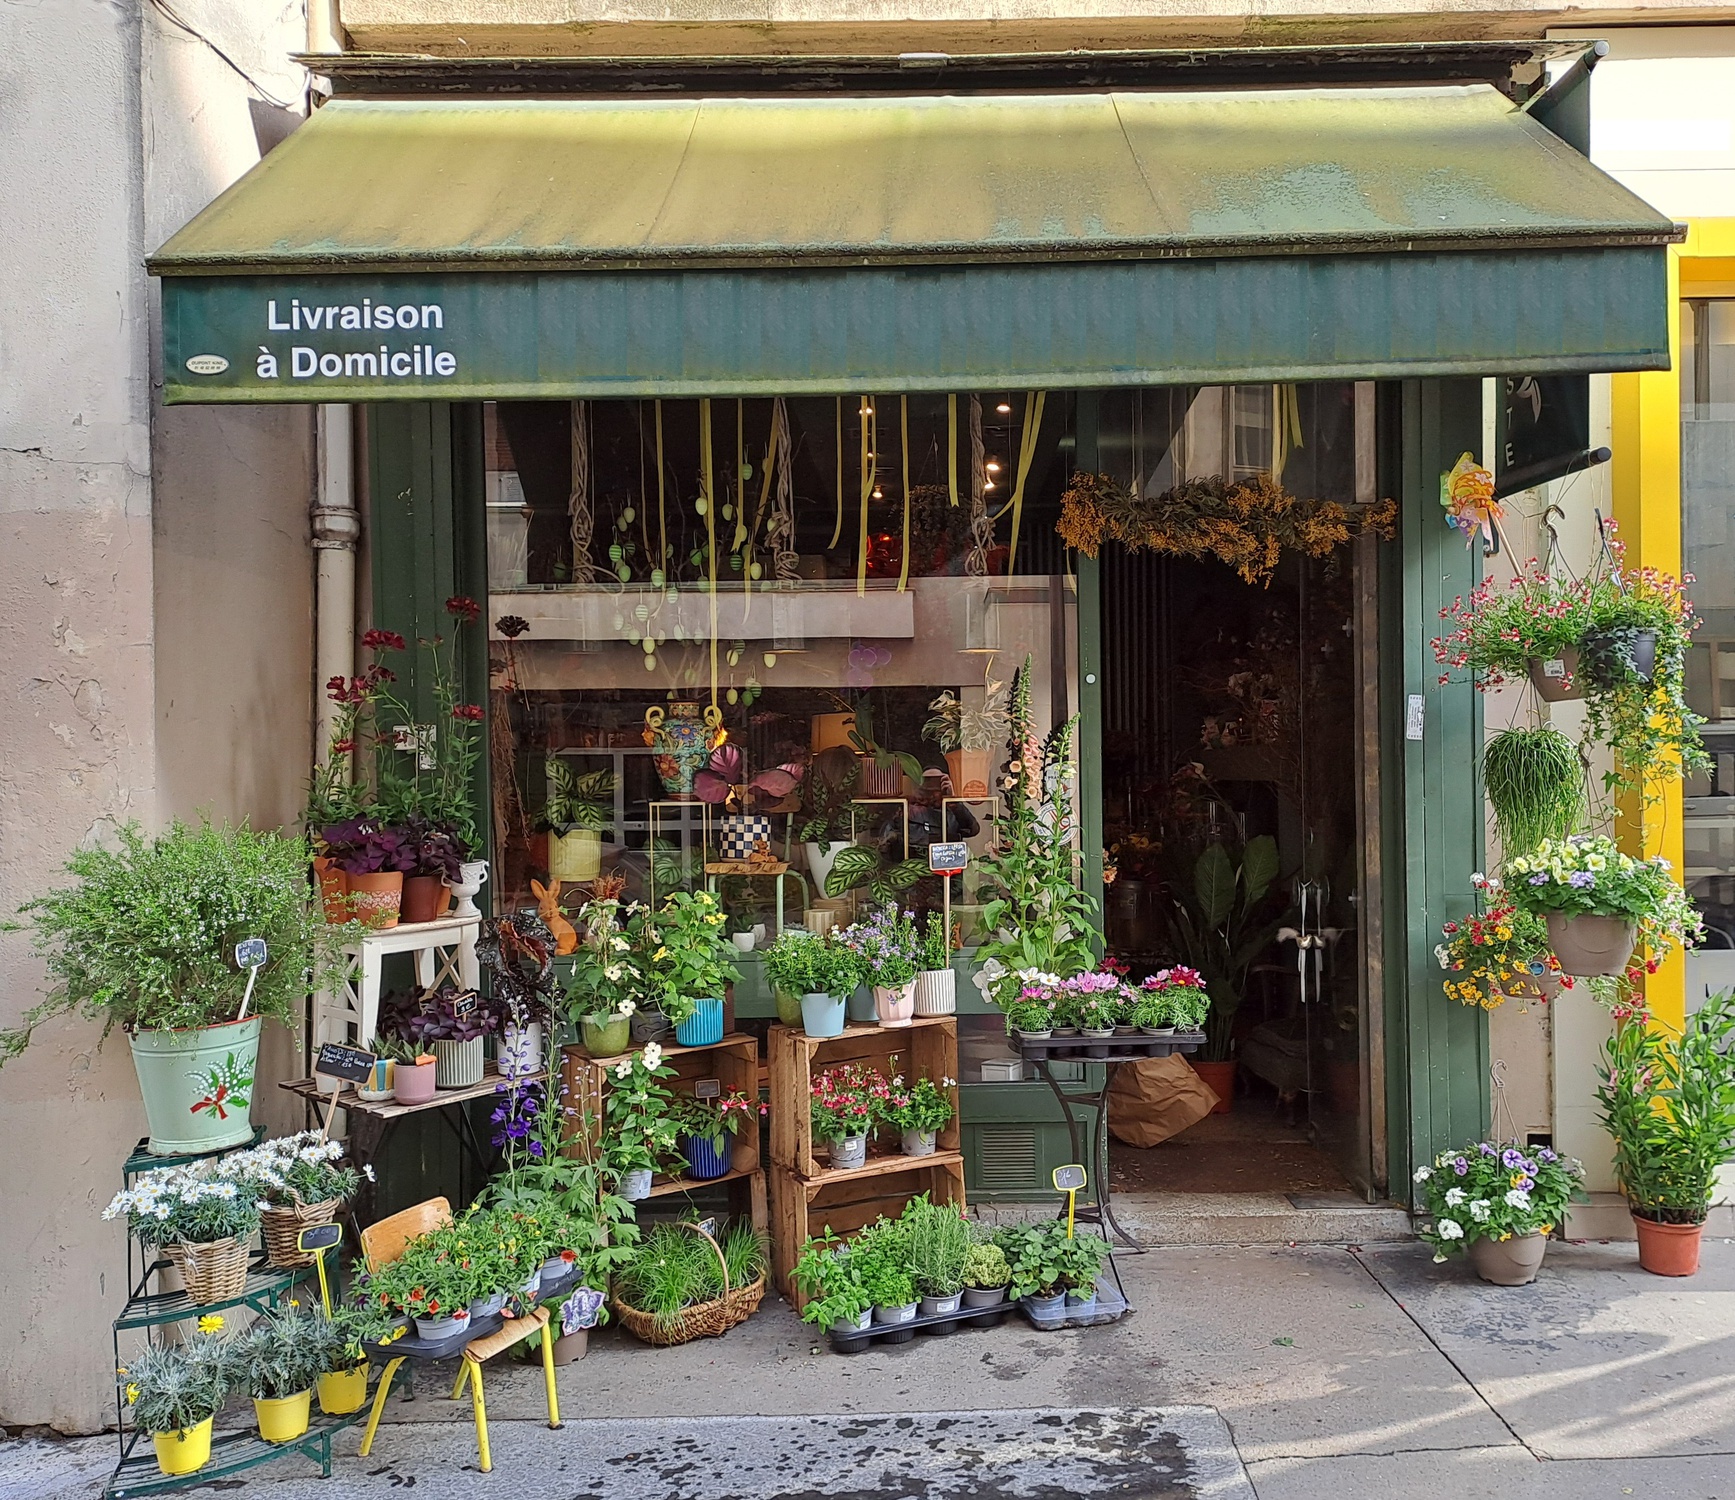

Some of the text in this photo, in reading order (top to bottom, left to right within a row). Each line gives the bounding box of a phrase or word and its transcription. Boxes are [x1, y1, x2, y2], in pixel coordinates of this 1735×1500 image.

[268, 298, 443, 330] Livraison
[256, 345, 456, 378] à Domicile
